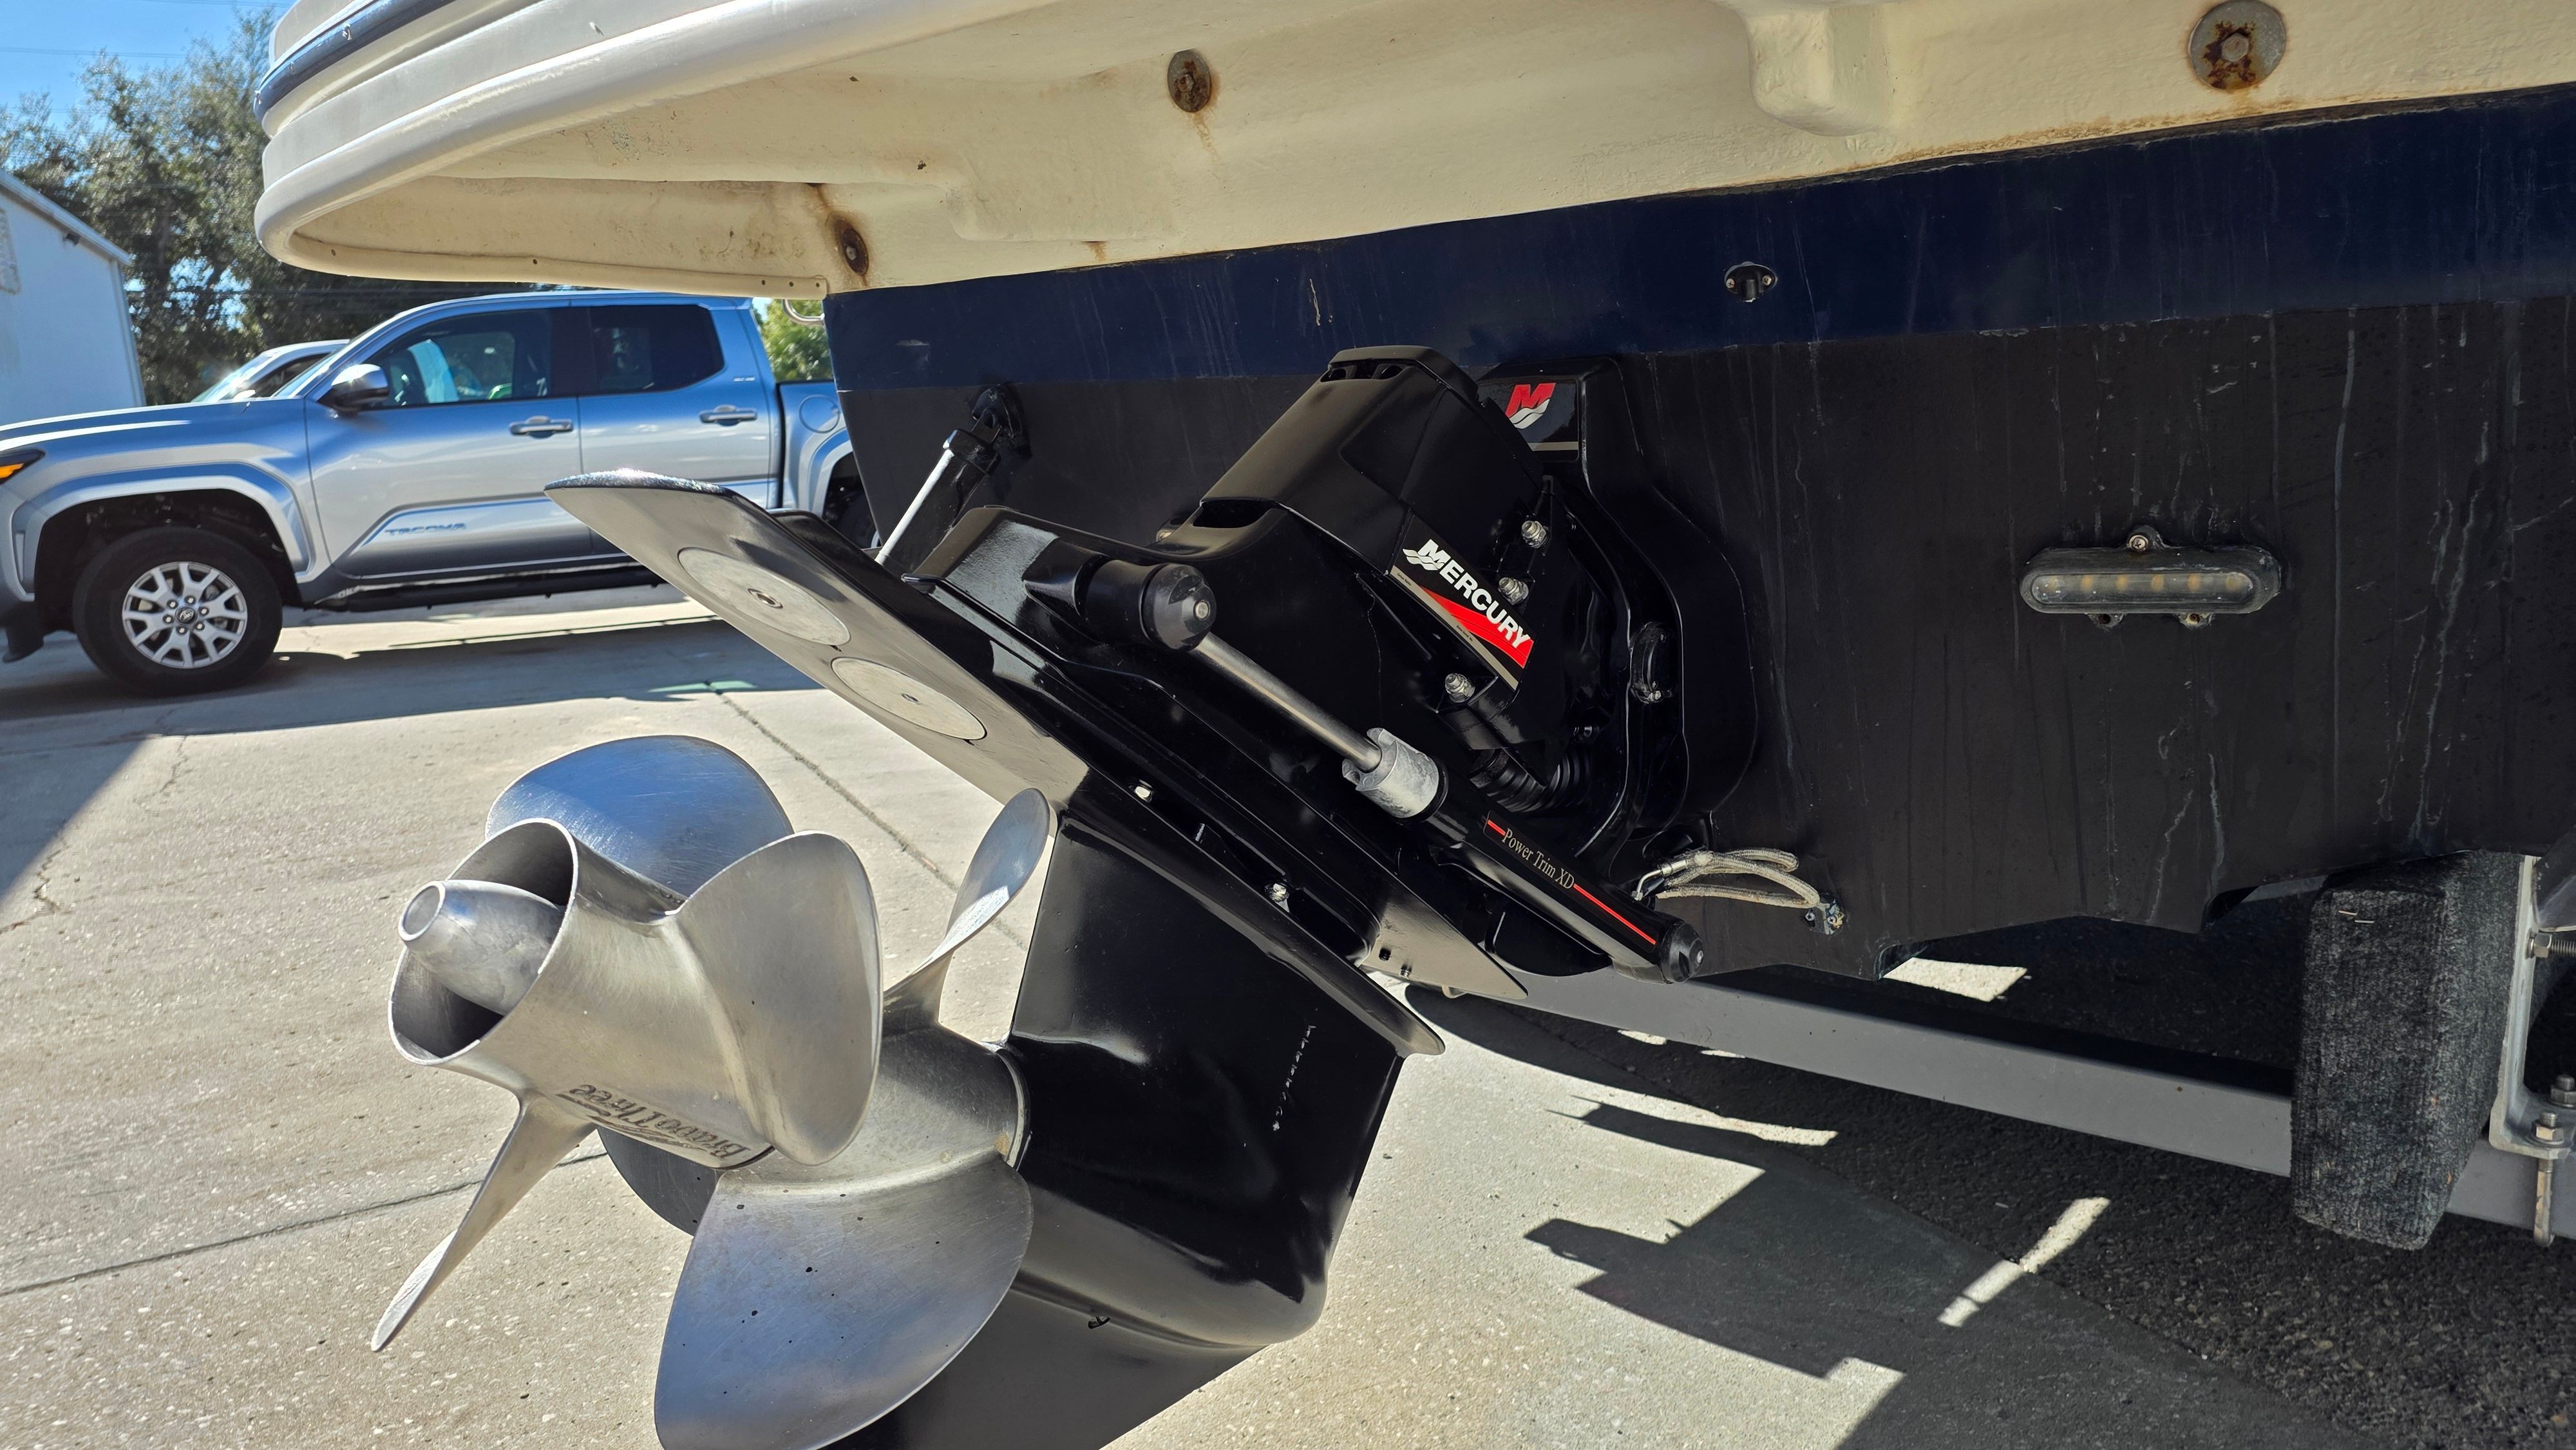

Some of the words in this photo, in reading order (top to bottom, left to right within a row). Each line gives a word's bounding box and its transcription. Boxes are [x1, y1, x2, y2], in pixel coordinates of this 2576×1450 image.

[1504, 382, 1556, 419] M
[1416, 538, 1531, 649] MERCURY
[1501, 827, 1534, 861] Power
[1533, 851, 1556, 878] Trim
[1555, 867, 1575, 889] XD
